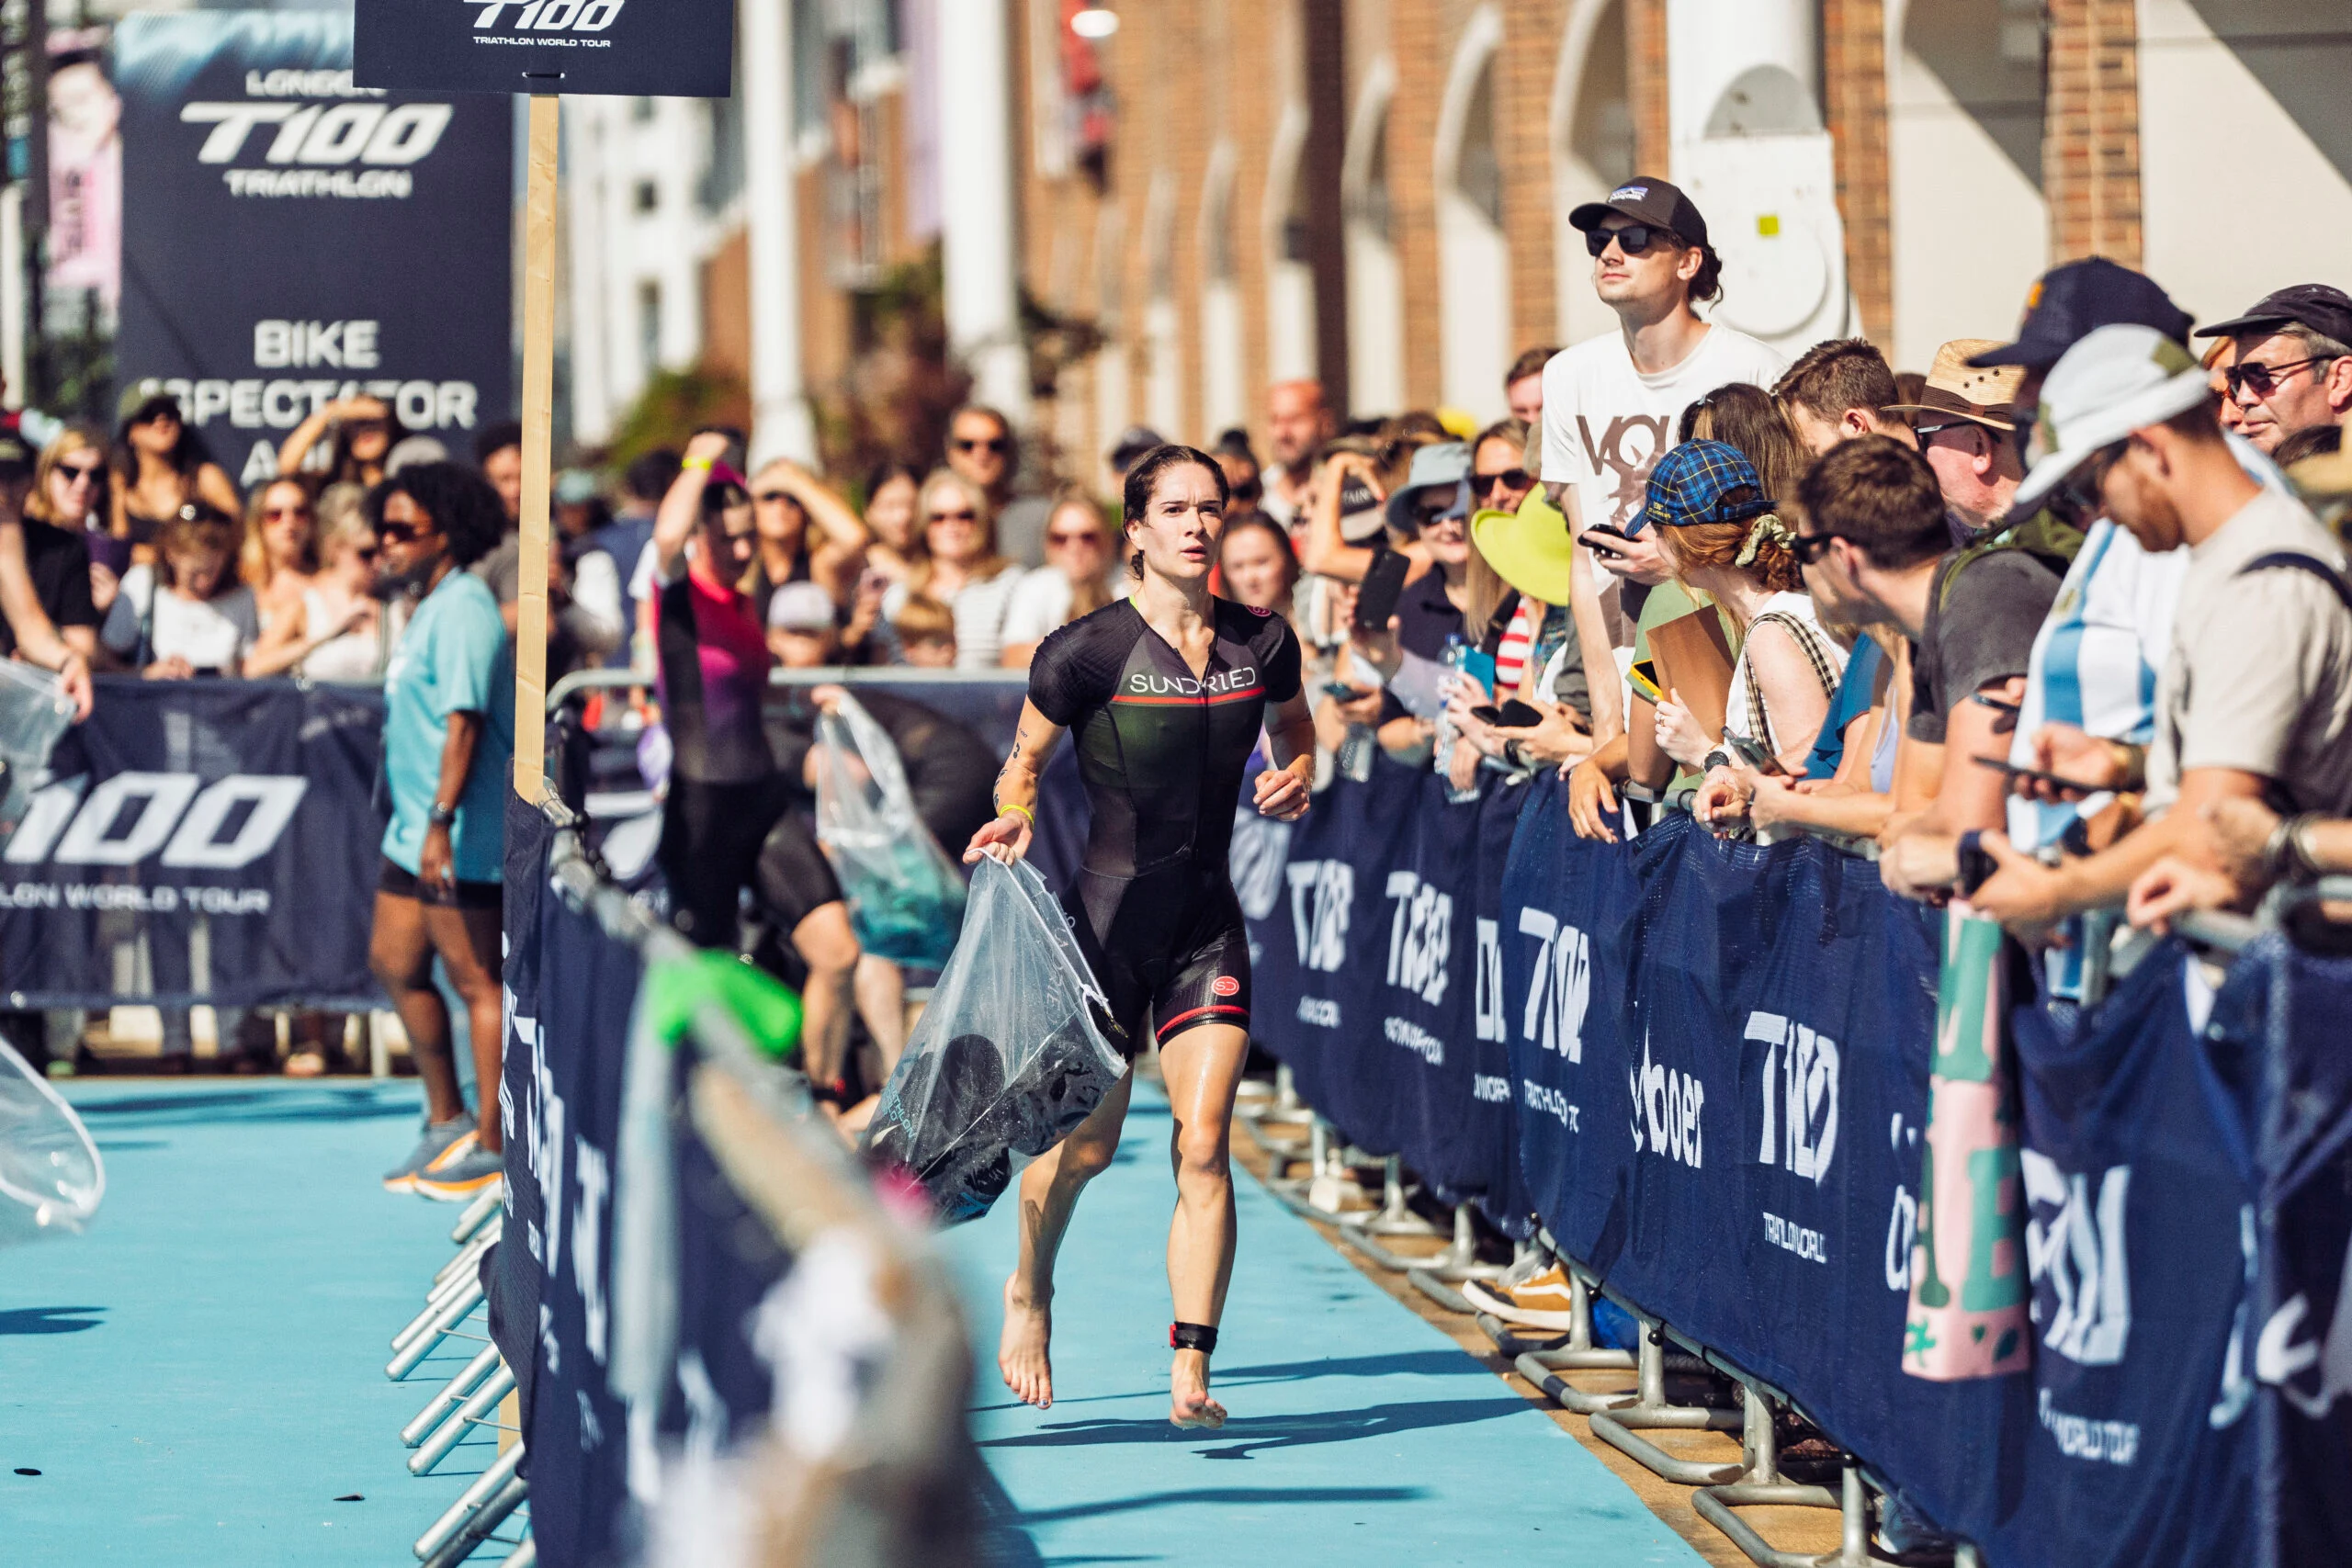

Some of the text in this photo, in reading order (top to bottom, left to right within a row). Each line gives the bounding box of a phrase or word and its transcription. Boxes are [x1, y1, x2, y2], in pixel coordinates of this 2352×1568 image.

[464, 0, 625, 31] T100
[473, 36, 611, 48] TRIATHLON WORLD TOUR
[245, 69, 387, 96] LONDO
[180, 102, 454, 164] T100
[222, 169, 413, 198] TRIATHLON
[254, 320, 380, 368] BIKE
[1129, 666, 1256, 694] SUNDRIED
[64, 883, 180, 912] WORLD
[183, 886, 272, 914] TOUR
